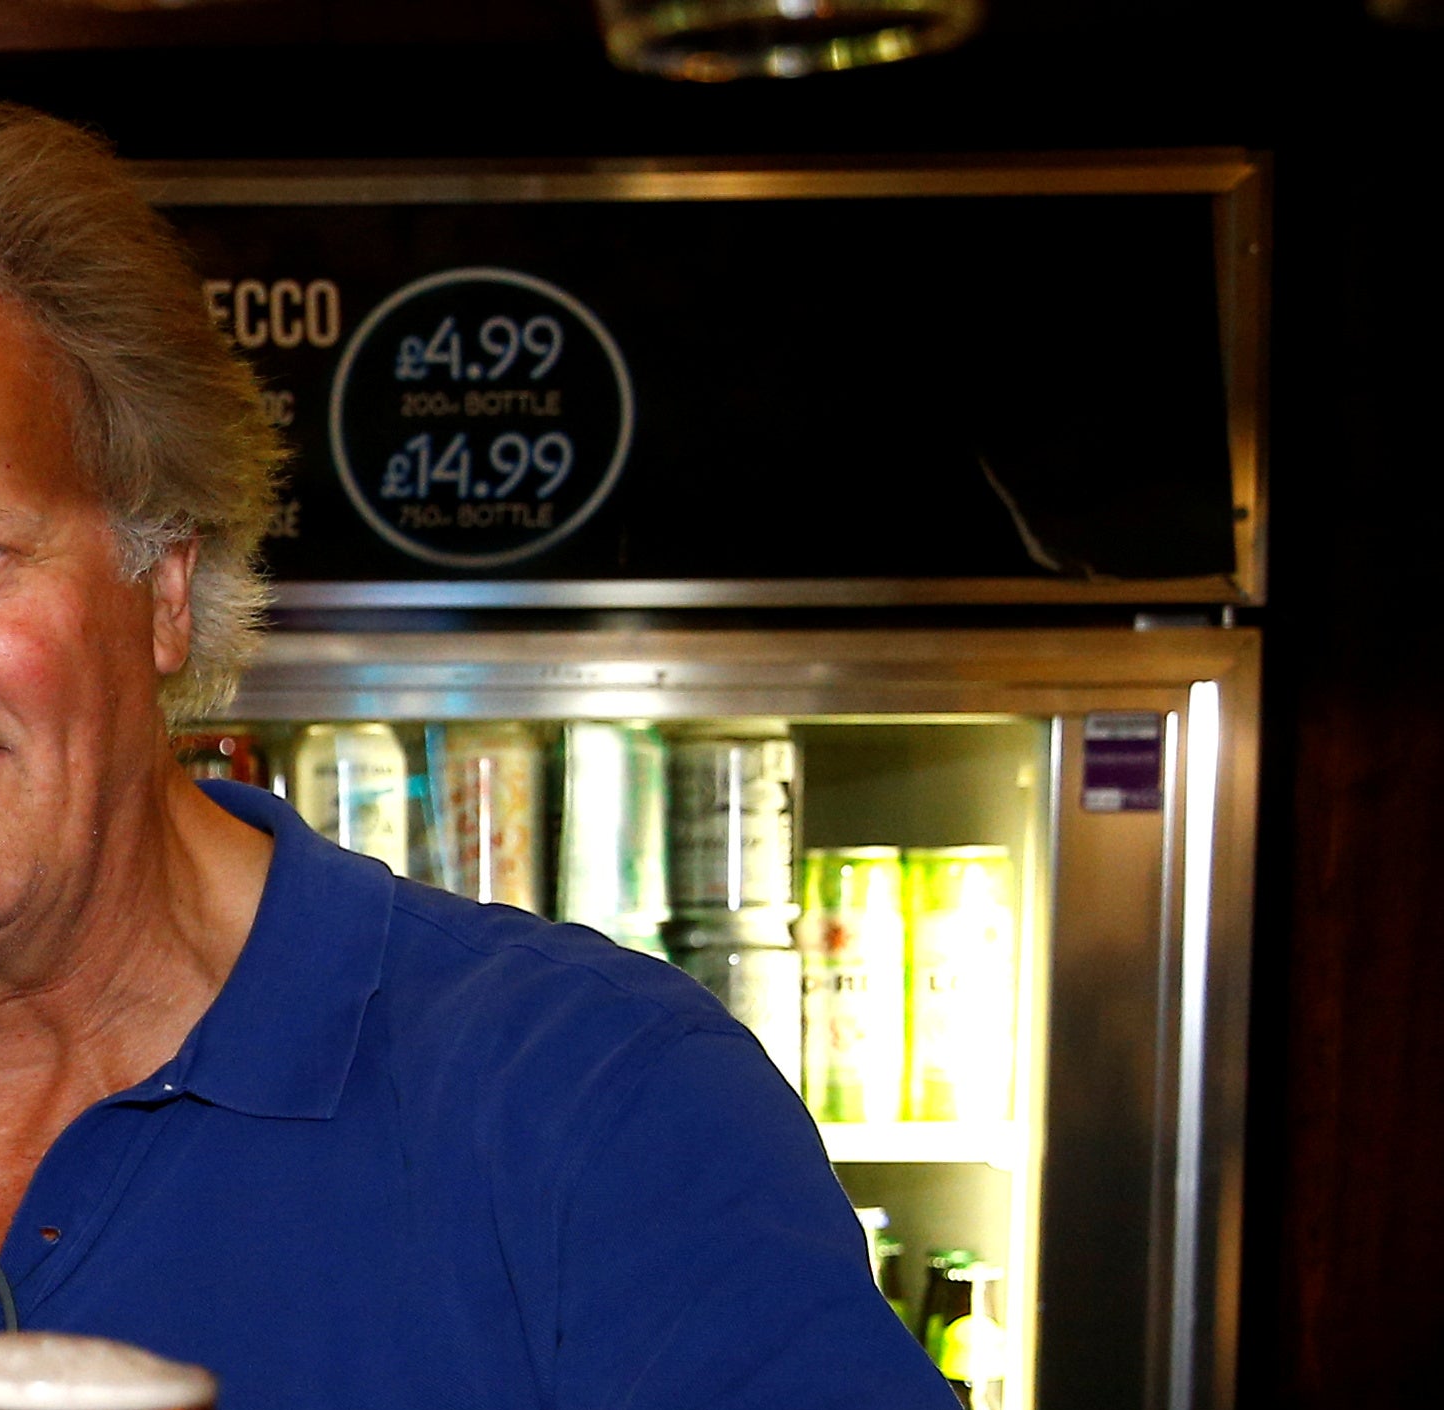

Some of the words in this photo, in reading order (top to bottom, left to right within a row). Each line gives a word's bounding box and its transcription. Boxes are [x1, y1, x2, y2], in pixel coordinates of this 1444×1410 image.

[202, 280, 341, 348] ECCO
[395, 316, 563, 381] £4.99
[465, 391, 562, 417] BOTTLE
[381, 433, 574, 499] £14.99
[456, 503, 554, 530] BOTTLE
